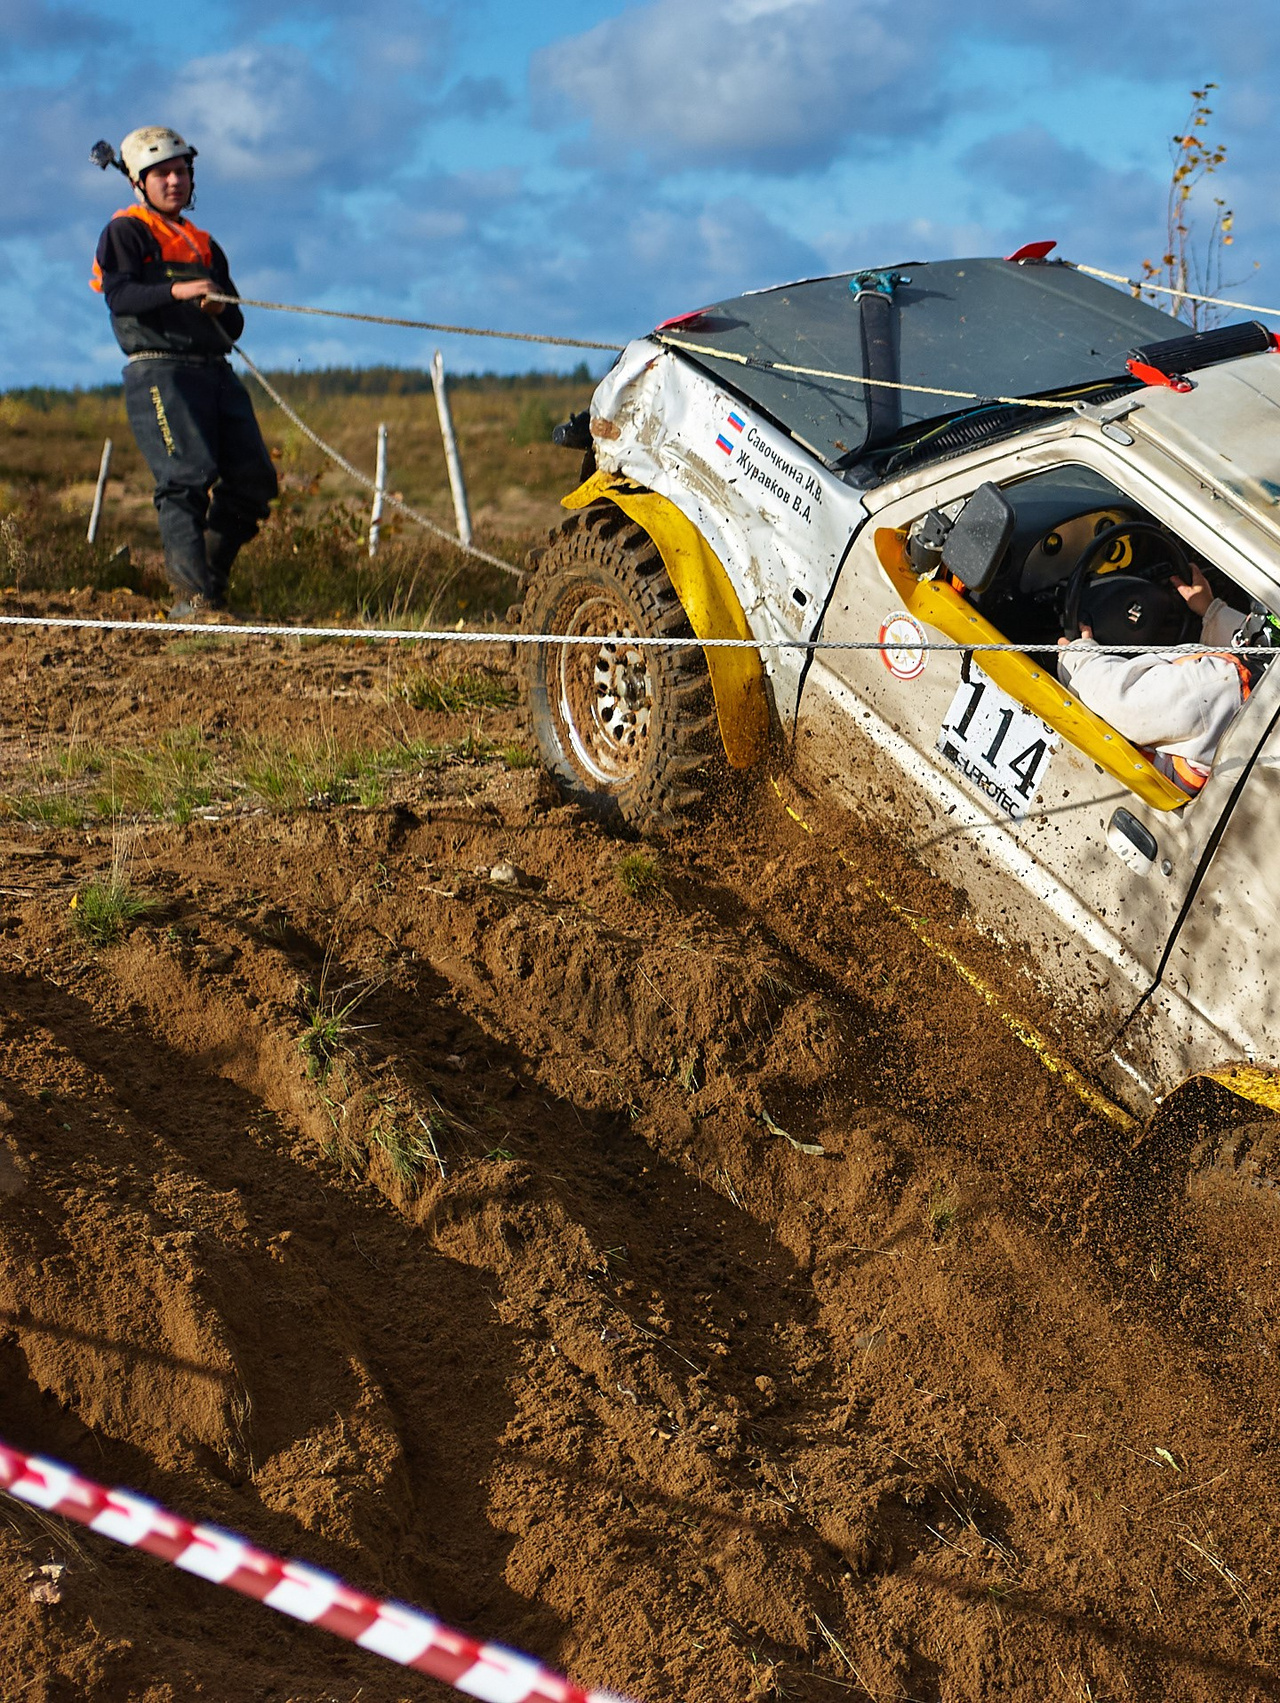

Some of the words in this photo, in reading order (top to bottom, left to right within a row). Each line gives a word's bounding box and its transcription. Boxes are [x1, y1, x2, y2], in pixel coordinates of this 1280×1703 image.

[736, 449, 791, 504] Журавков
[791, 495, 812, 525] В.А.
[747, 427, 804, 486] Савочкина
[804, 475, 823, 505] И.В.
[952, 681, 1048, 801] 114
